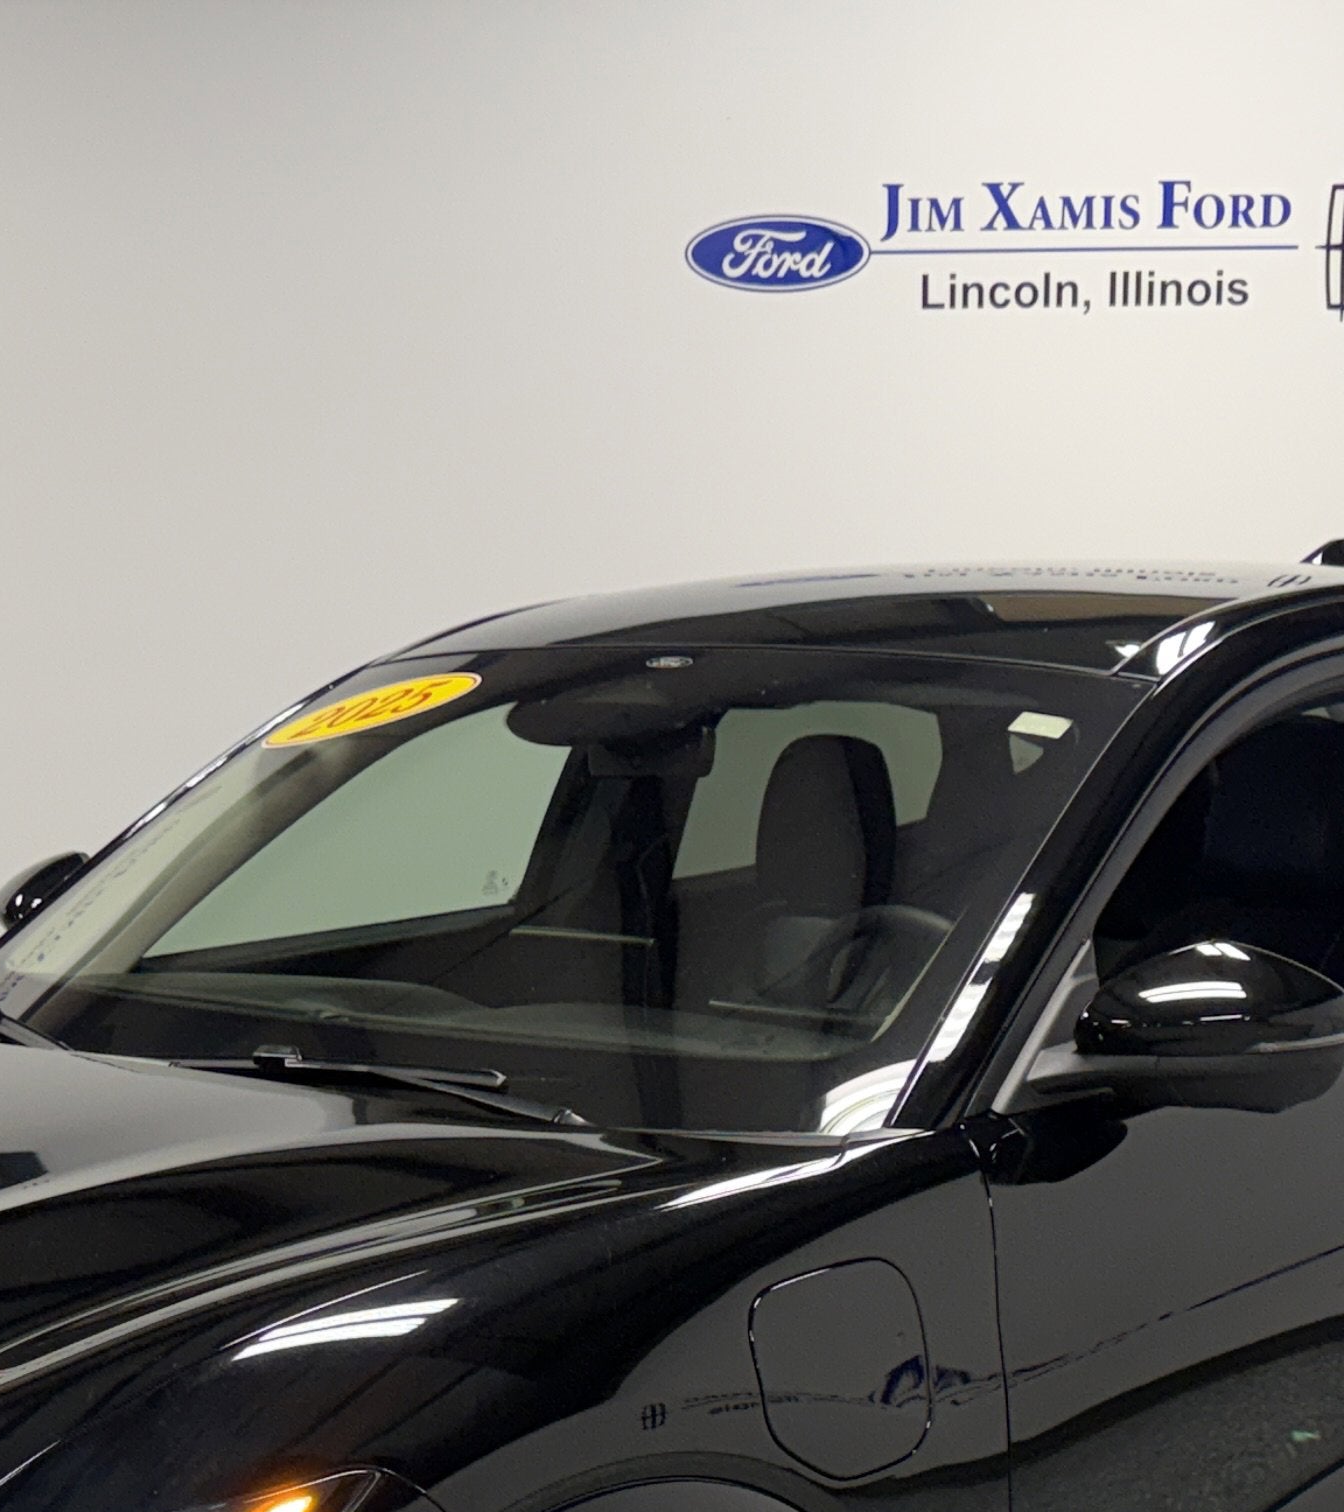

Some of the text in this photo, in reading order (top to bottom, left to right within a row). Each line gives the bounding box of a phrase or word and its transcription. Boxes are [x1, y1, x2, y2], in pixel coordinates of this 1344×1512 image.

[880, 180, 1292, 243] JIM XAMIS FORD
[721, 228, 835, 279] Ford
[921, 269, 1250, 315] Lincoln, Illinois
[289, 679, 453, 740] 2025
